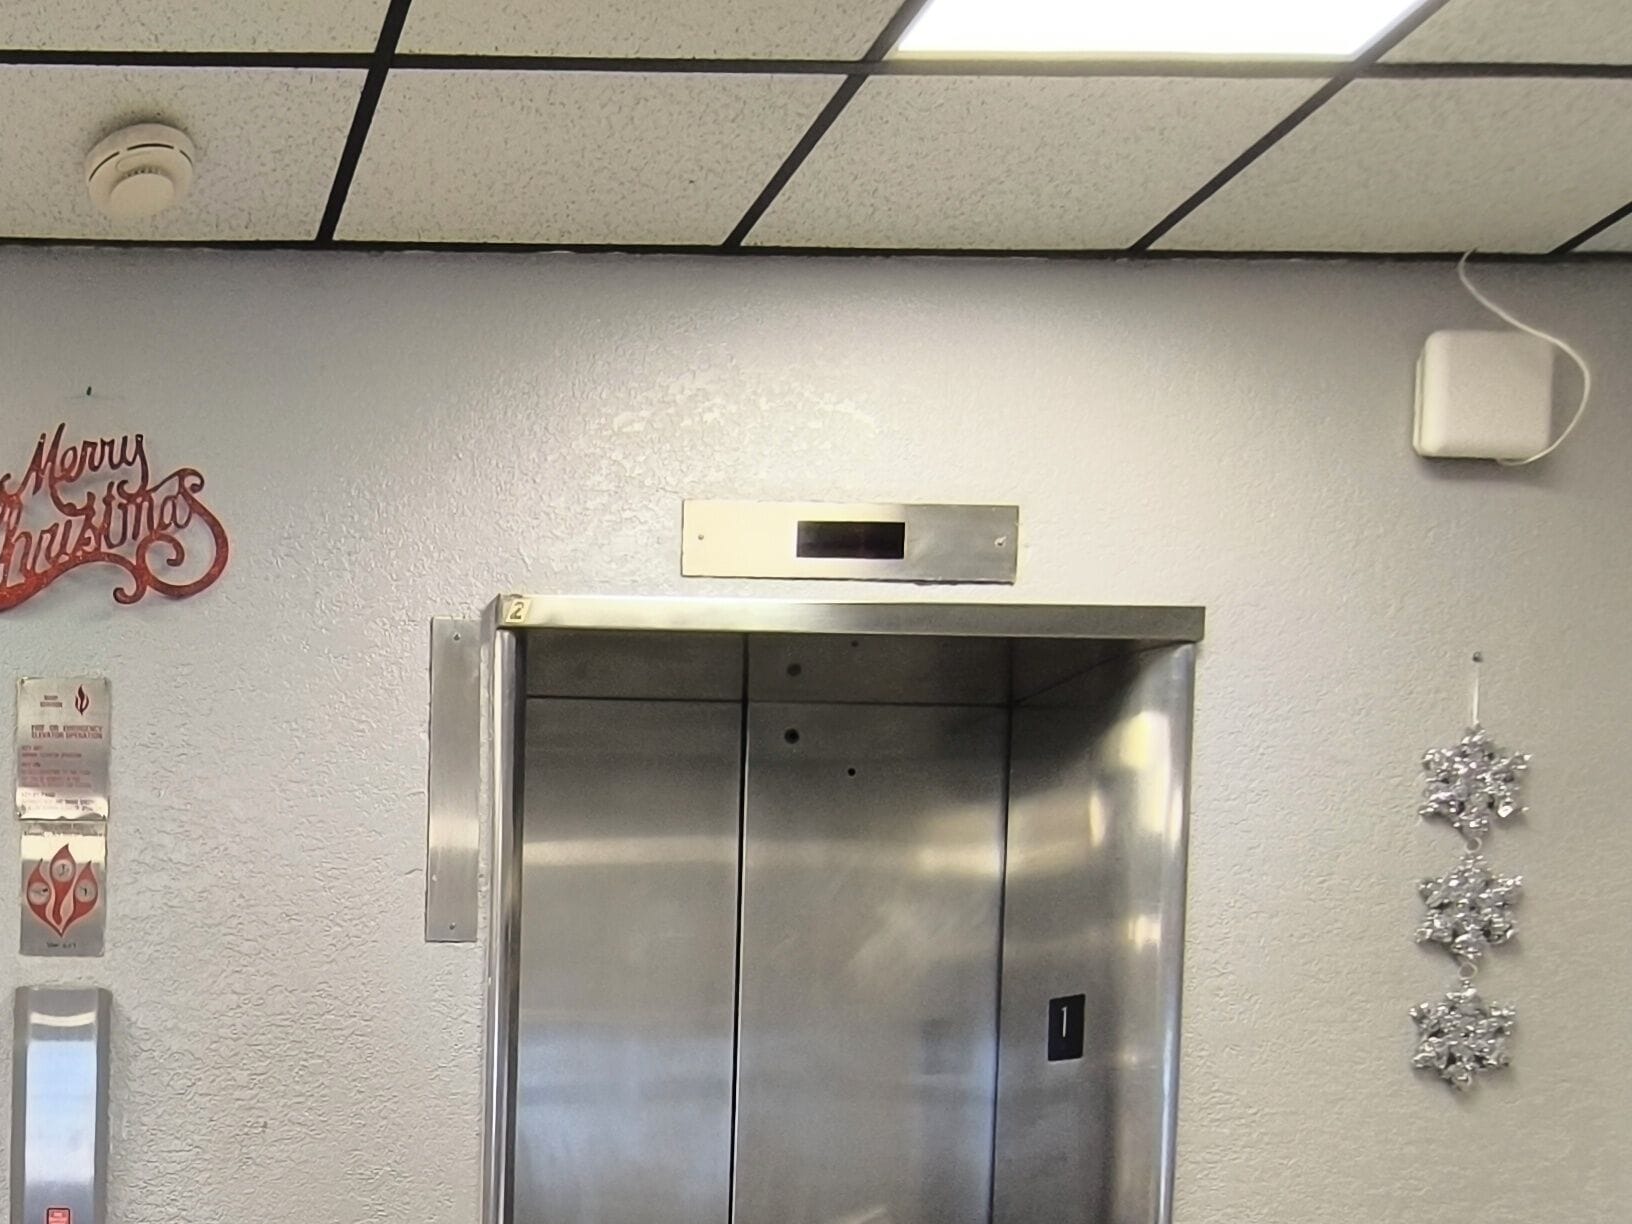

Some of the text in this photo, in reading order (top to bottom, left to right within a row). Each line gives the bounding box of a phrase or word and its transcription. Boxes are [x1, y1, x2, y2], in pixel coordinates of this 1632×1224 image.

[0, 422, 150, 514] Merry
[510, 601, 525, 620] 2
[1061, 1006, 1068, 1038] 1
